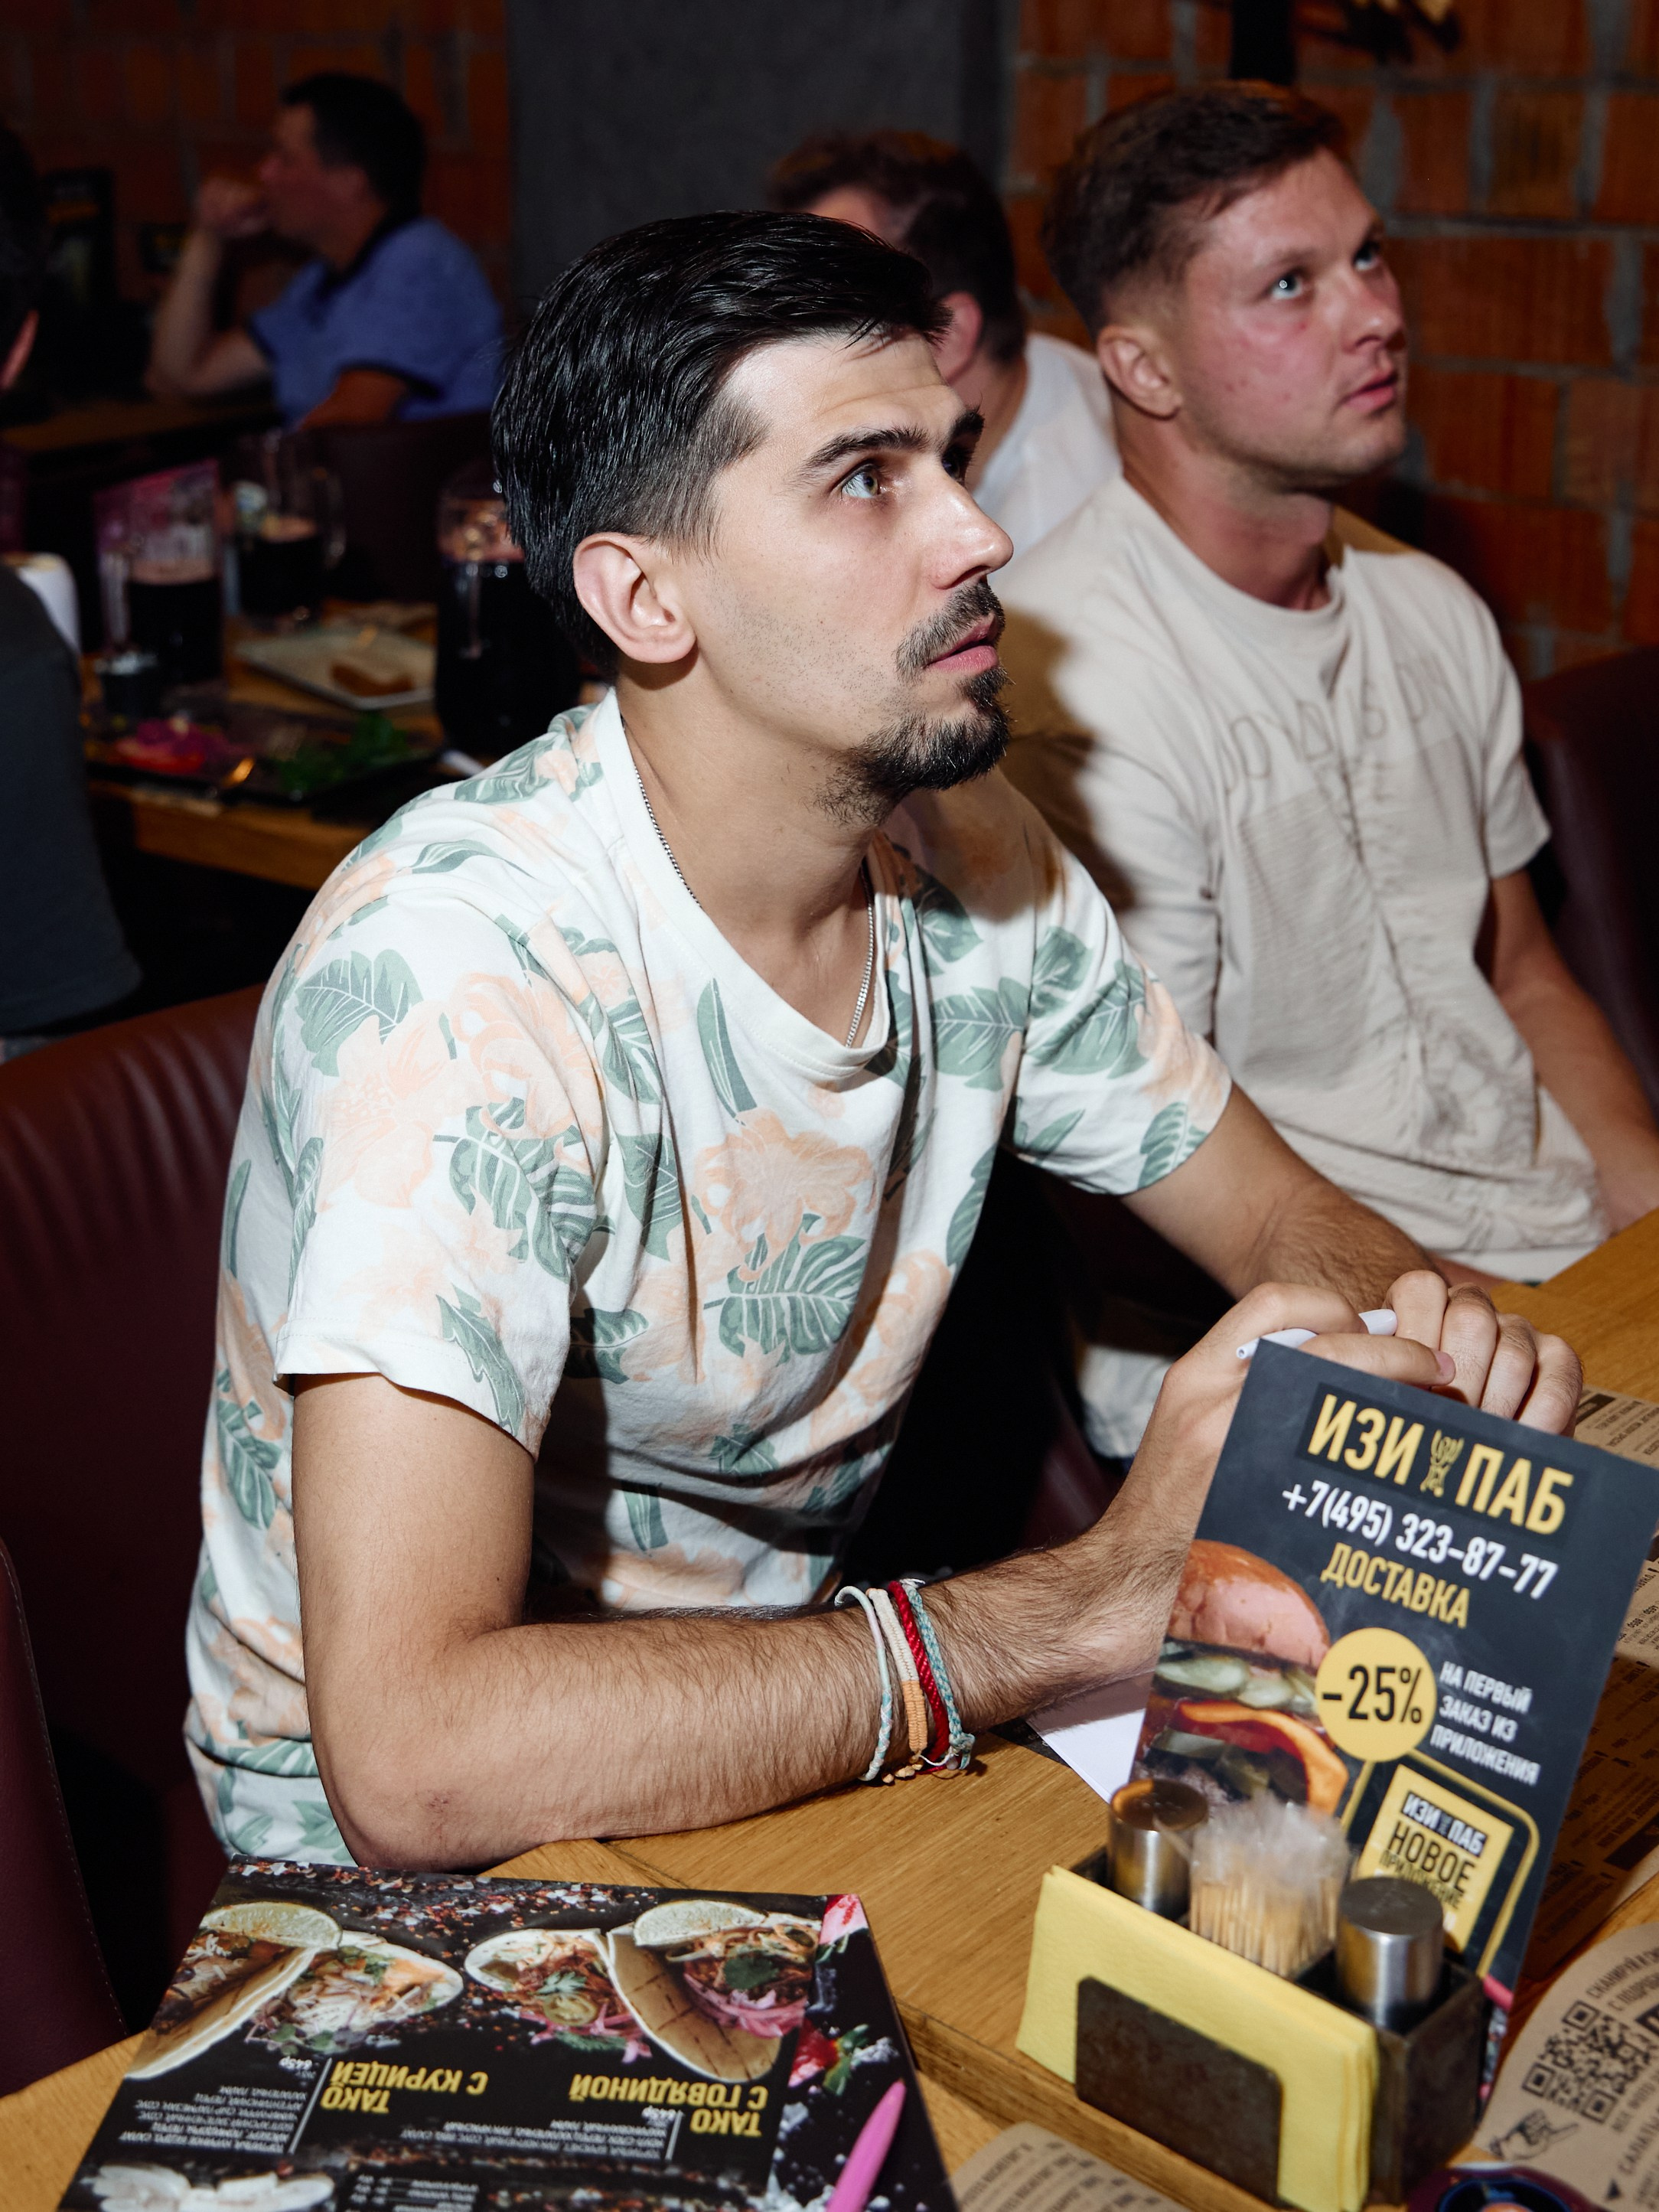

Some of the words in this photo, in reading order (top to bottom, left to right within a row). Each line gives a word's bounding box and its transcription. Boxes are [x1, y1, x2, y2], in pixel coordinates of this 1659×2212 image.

[1307, 1394, 1424, 1486] ИЗИ
[1455, 1444, 1575, 1535] ПАБ
[1282, 1480, 1393, 1548] +7(495)
[1396, 1512, 1559, 1600] 323-87-77
[1319, 1542, 1471, 1630] ДОСТАВКА
[1322, 1664, 1423, 1725] -25%
[1440, 1661, 1462, 1687] НА
[1464, 1669, 1534, 1713] ПЕРВЫЙ
[1439, 1695, 1492, 1731] ЗАКАЗ
[1493, 1714, 1518, 1742] ИЗ
[1430, 1724, 1541, 1786] ПРИЛОЖЕНИЯ
[1403, 1793, 1442, 1829] ИЗИ
[1447, 1819, 1487, 1856] ПАБ
[1388, 1821, 1475, 1894] НОВОЕ
[319, 2085, 389, 2113] ТАКО
[328, 2060, 462, 2092] КУРИЦЕЙ
[468, 2071, 488, 2095] С
[567, 2073, 742, 2108] ГОВЯДИНОЙ
[747, 2084, 768, 2109] С
[689, 2108, 762, 2136] ТАКО
